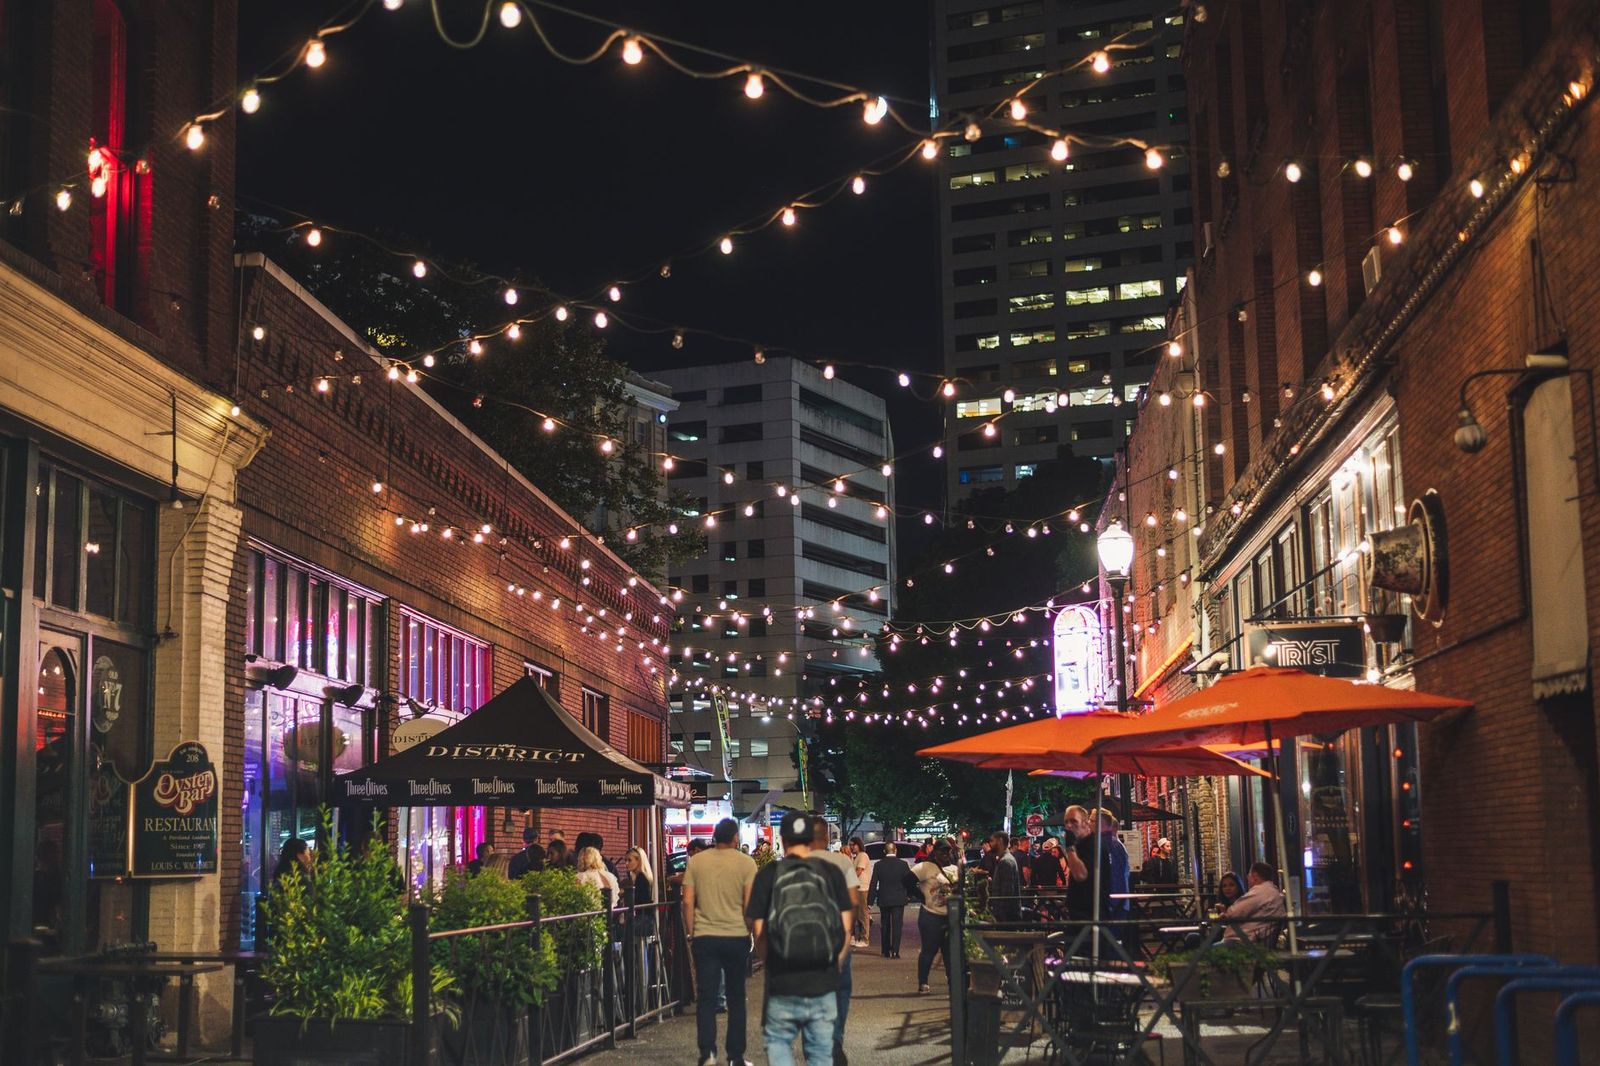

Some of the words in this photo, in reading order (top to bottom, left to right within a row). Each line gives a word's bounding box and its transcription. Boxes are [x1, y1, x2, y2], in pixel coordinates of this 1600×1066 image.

[1271, 639, 1341, 667] TRYST
[186, 754, 200, 763] 208
[425, 746, 585, 763] DISTRICT
[153, 770, 215, 805] Oyster
[345, 780, 365, 796] Three
[365, 777, 388, 796] Olives
[408, 779, 428, 796] Three
[428, 777, 452, 796] Olives
[472, 778, 493, 795] Three
[493, 776, 516, 795] Olives
[535, 778, 556, 795] Three
[556, 777, 579, 795] Olives
[599, 779, 620, 796] Three
[620, 777, 643, 796] Olives
[175, 786, 208, 814] Bar
